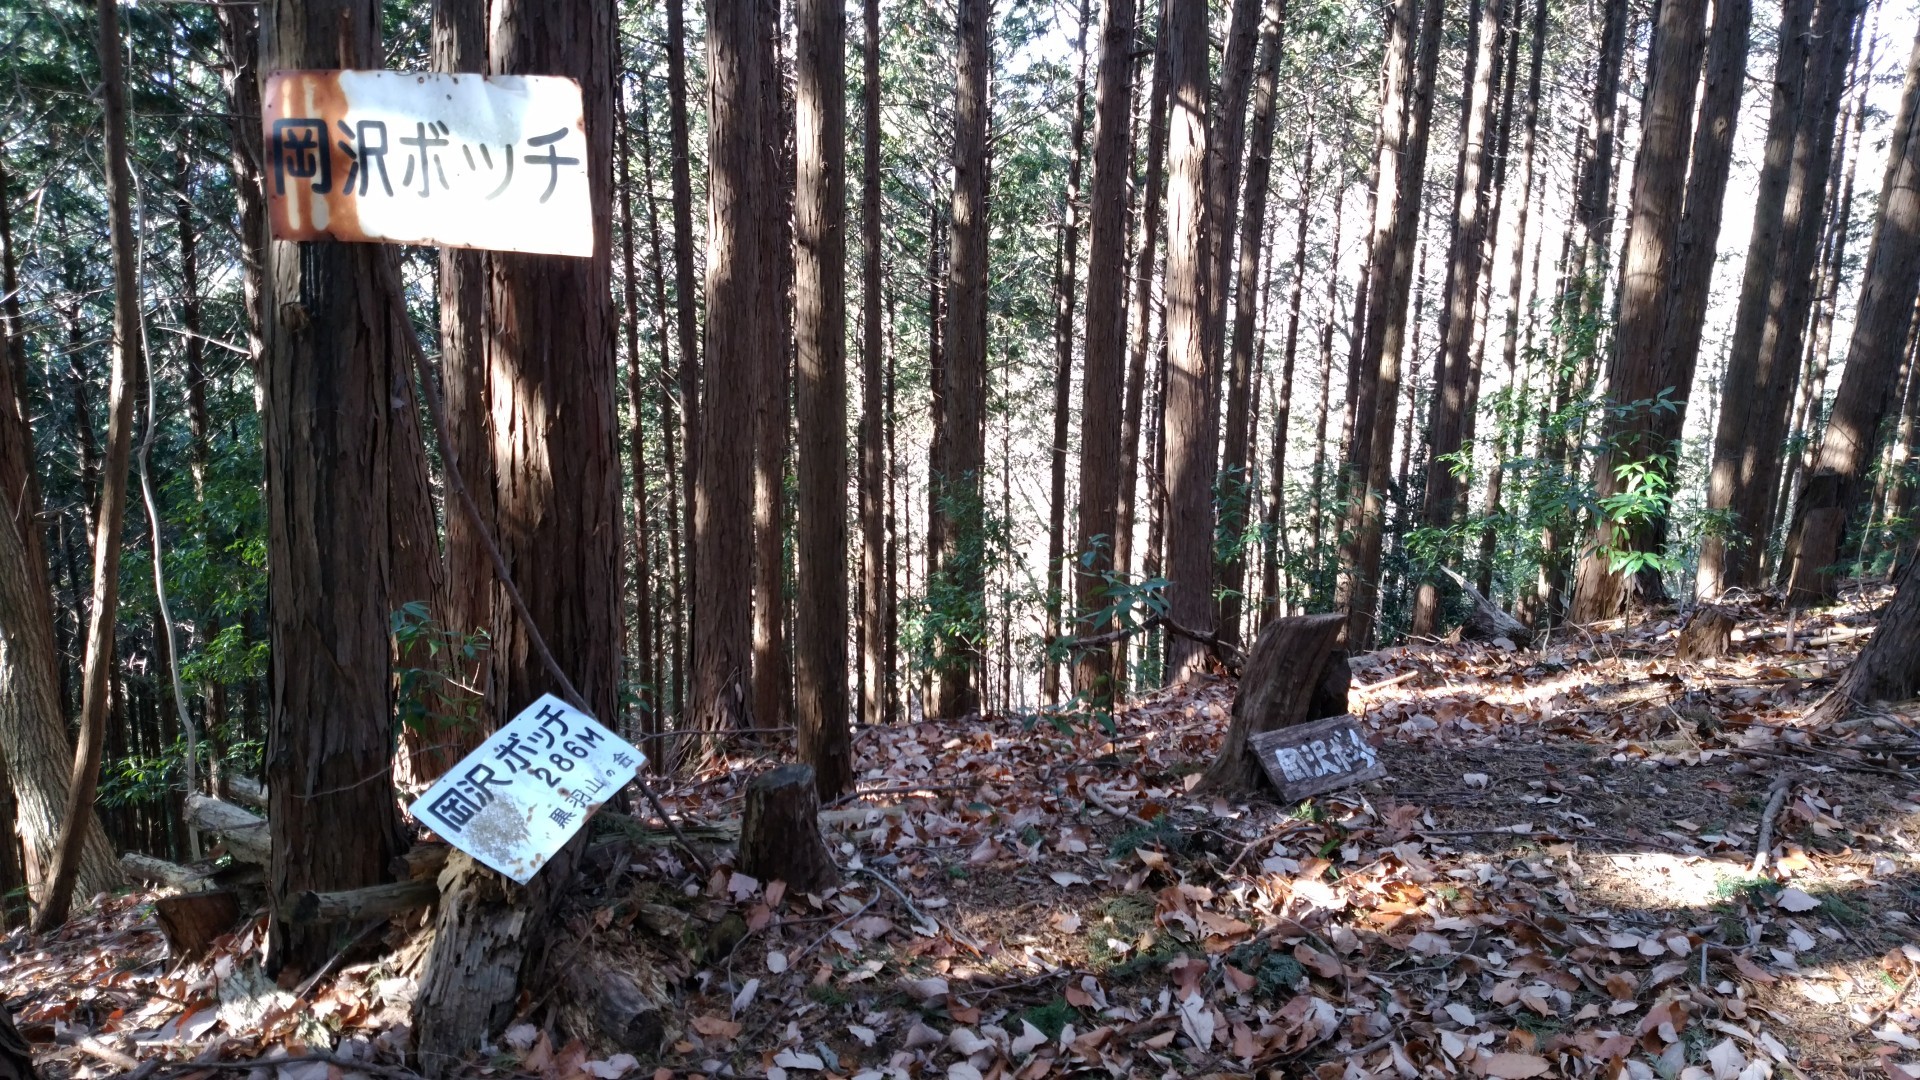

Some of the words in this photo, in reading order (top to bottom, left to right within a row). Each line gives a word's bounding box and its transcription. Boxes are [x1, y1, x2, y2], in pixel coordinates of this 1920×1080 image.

[427, 704, 569, 833] 岡沢ボッチ
[534, 726, 605, 788] 286M
